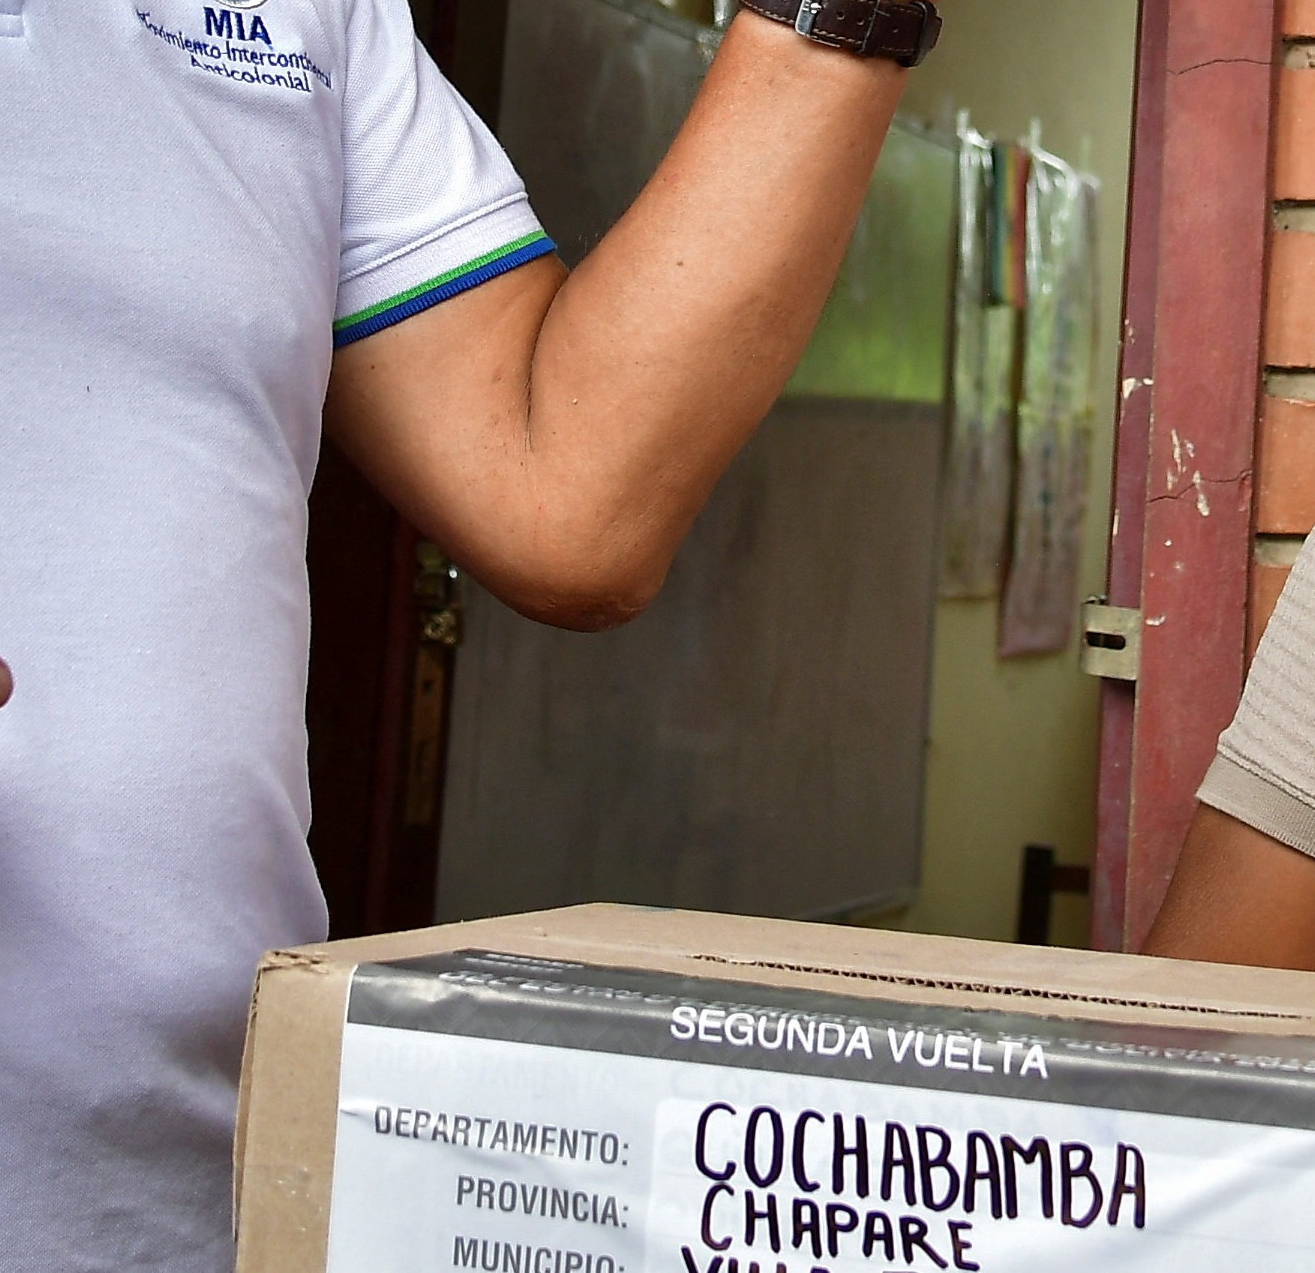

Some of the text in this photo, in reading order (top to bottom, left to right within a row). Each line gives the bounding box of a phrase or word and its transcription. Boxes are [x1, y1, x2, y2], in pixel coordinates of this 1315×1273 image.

[203, 6, 272, 45] MIA
[190, 55, 312, 93] Anticolonial
[669, 1005, 873, 1061] SEGUNDA
[887, 1027, 1049, 1078] VUELTA
[374, 1104, 630, 1166] DEPARTAMENTO:
[694, 1101, 1147, 1228] COCHABAMBA
[456, 1174, 629, 1228] PROVINCIA:
[701, 1182, 980, 1272] CHAPARE
